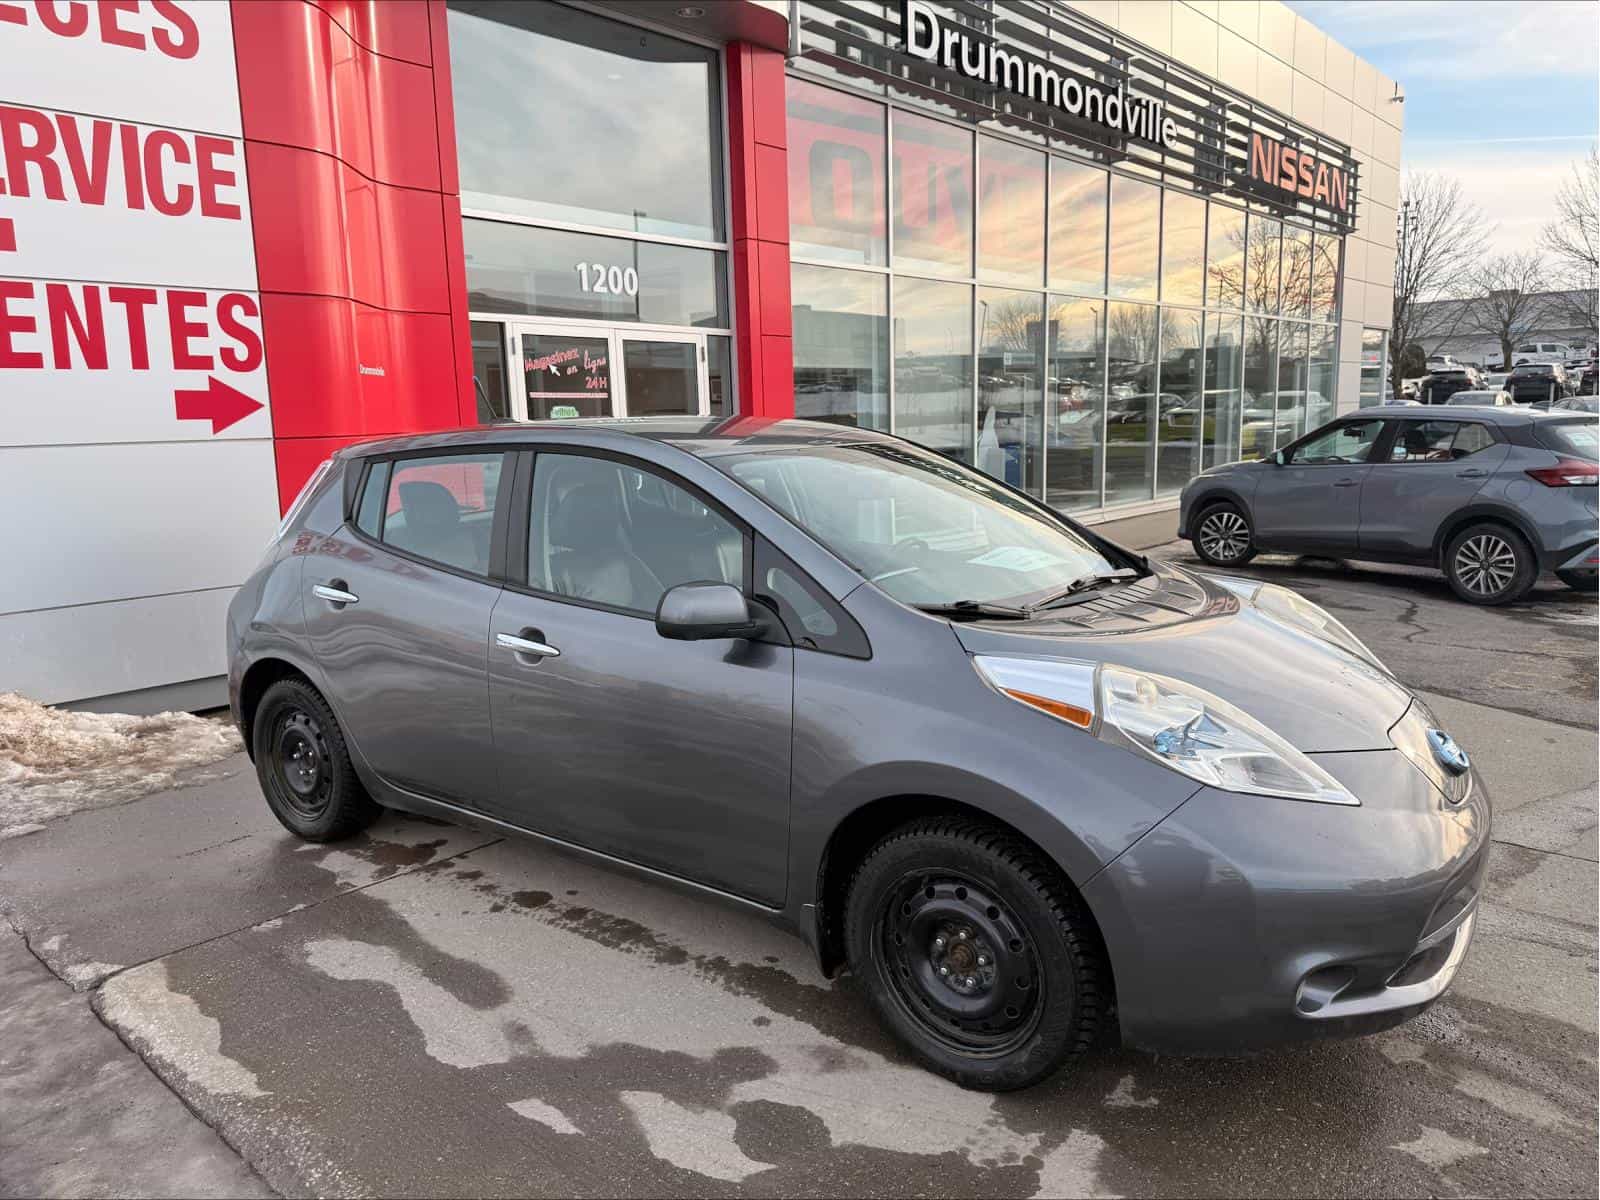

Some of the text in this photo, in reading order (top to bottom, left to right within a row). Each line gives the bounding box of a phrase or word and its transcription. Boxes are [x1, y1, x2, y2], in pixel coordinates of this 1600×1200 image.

[907, 0, 1178, 149] Drummondville
[0, 105, 241, 220] RVICE
[1252, 132, 1347, 210] NISSAN
[575, 262, 639, 296] 1200
